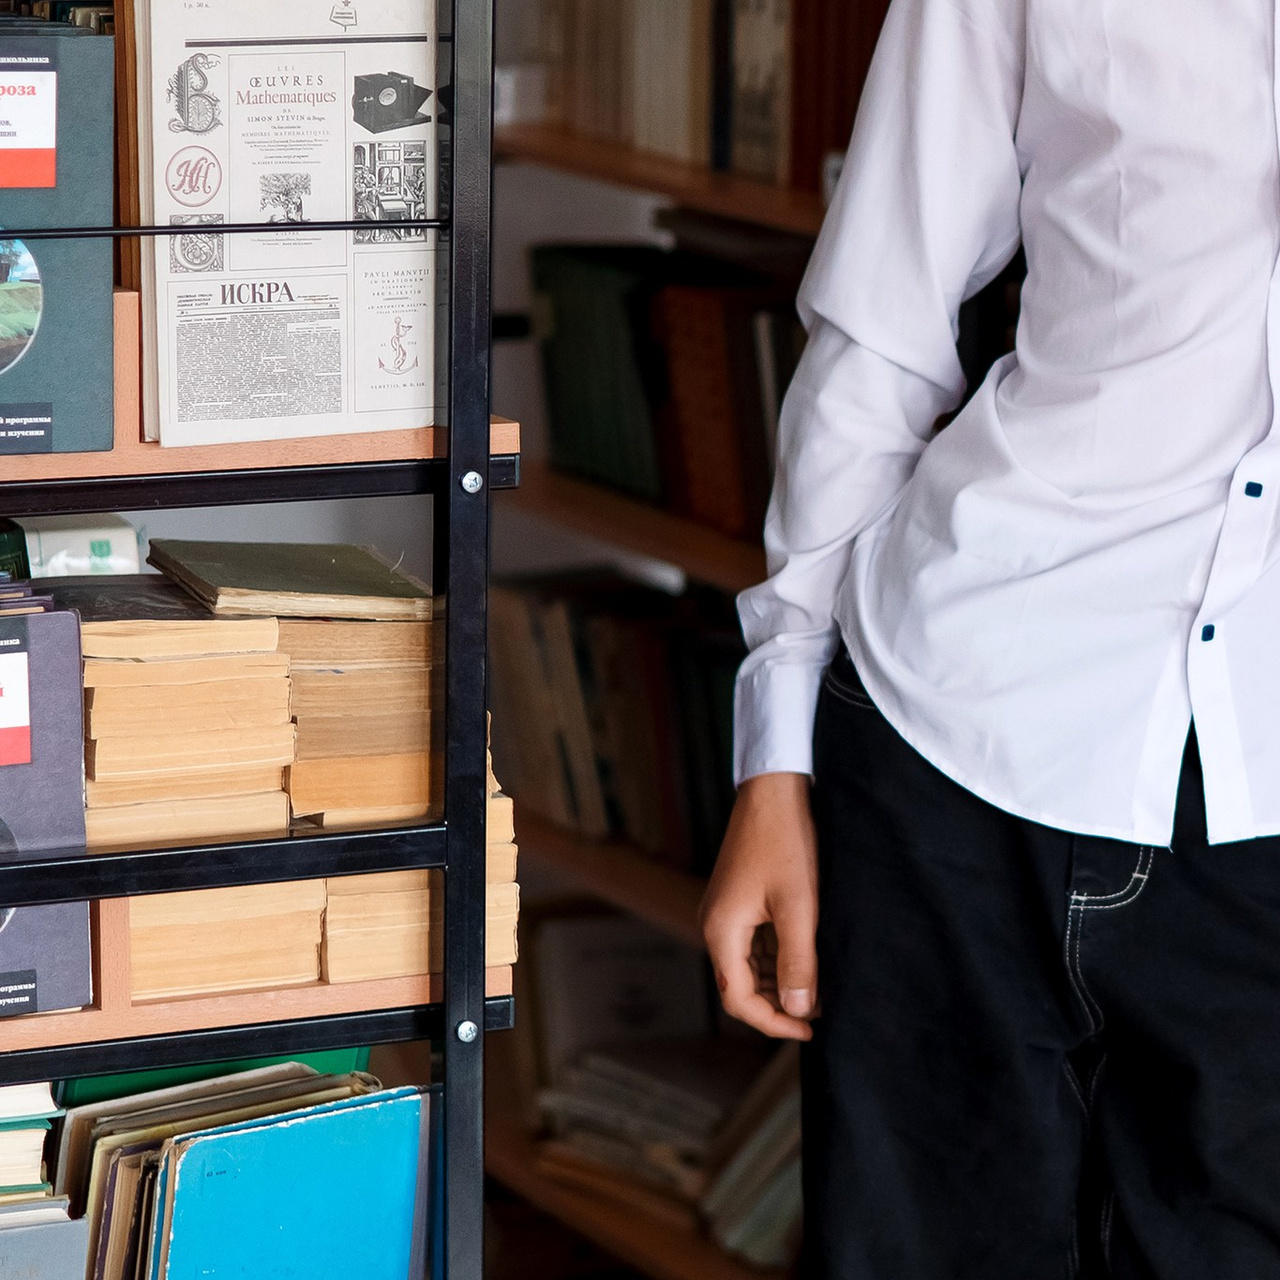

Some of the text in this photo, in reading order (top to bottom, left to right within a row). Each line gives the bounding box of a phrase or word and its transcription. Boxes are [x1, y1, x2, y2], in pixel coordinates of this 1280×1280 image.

[250, 75, 324, 88] ŒUVRES
[236, 89, 337, 107] Mathematiques
[220, 282, 296, 305] ИСКРА
[5, 417, 51, 425] программы
